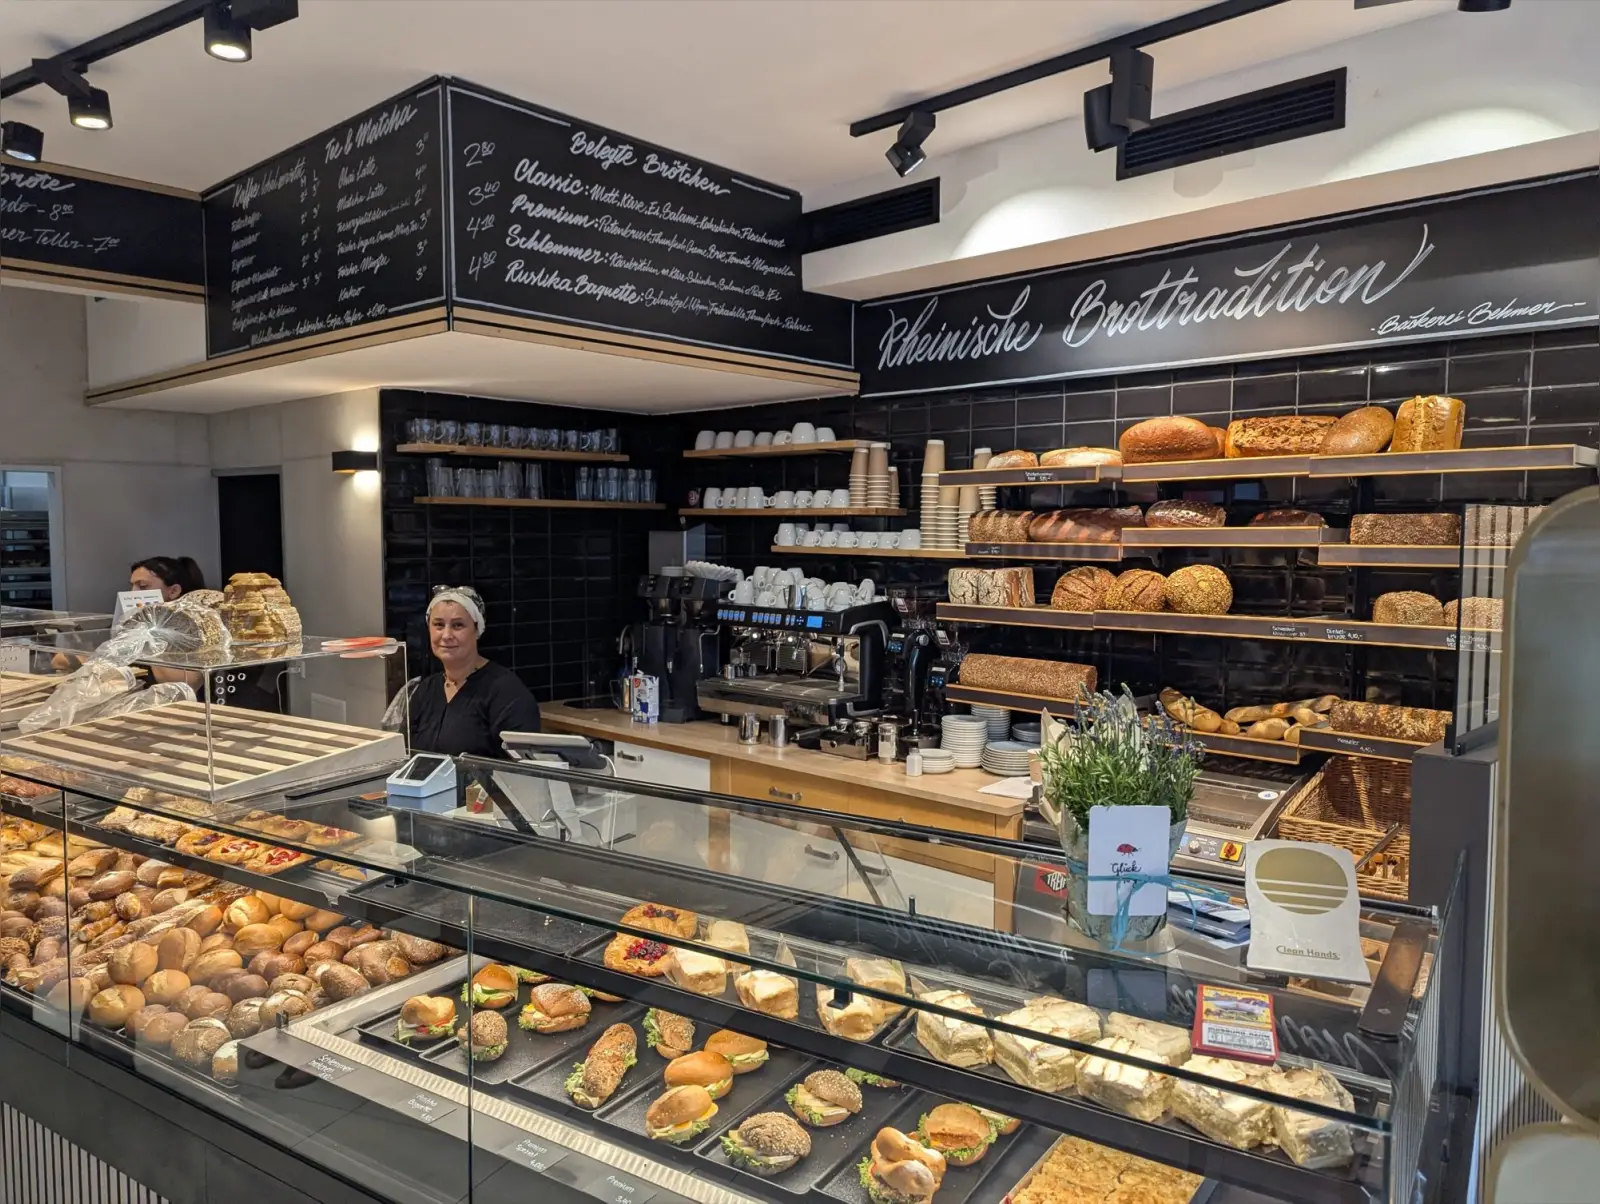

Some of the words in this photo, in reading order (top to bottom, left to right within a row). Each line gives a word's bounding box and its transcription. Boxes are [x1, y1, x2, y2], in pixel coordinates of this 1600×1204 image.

[355, 104, 418, 148] Matcha
[570, 131, 637, 170] Belegte
[643, 153, 731, 195] Brötchen
[34, 229, 82, 248] Teller
[505, 259, 573, 292] Rustika
[878, 285, 1043, 370] Rheinische
[1062, 224, 1434, 347] Brottradition
[1276, 945, 1304, 956] Clean
[606, 1175, 635, 1194] Premium
